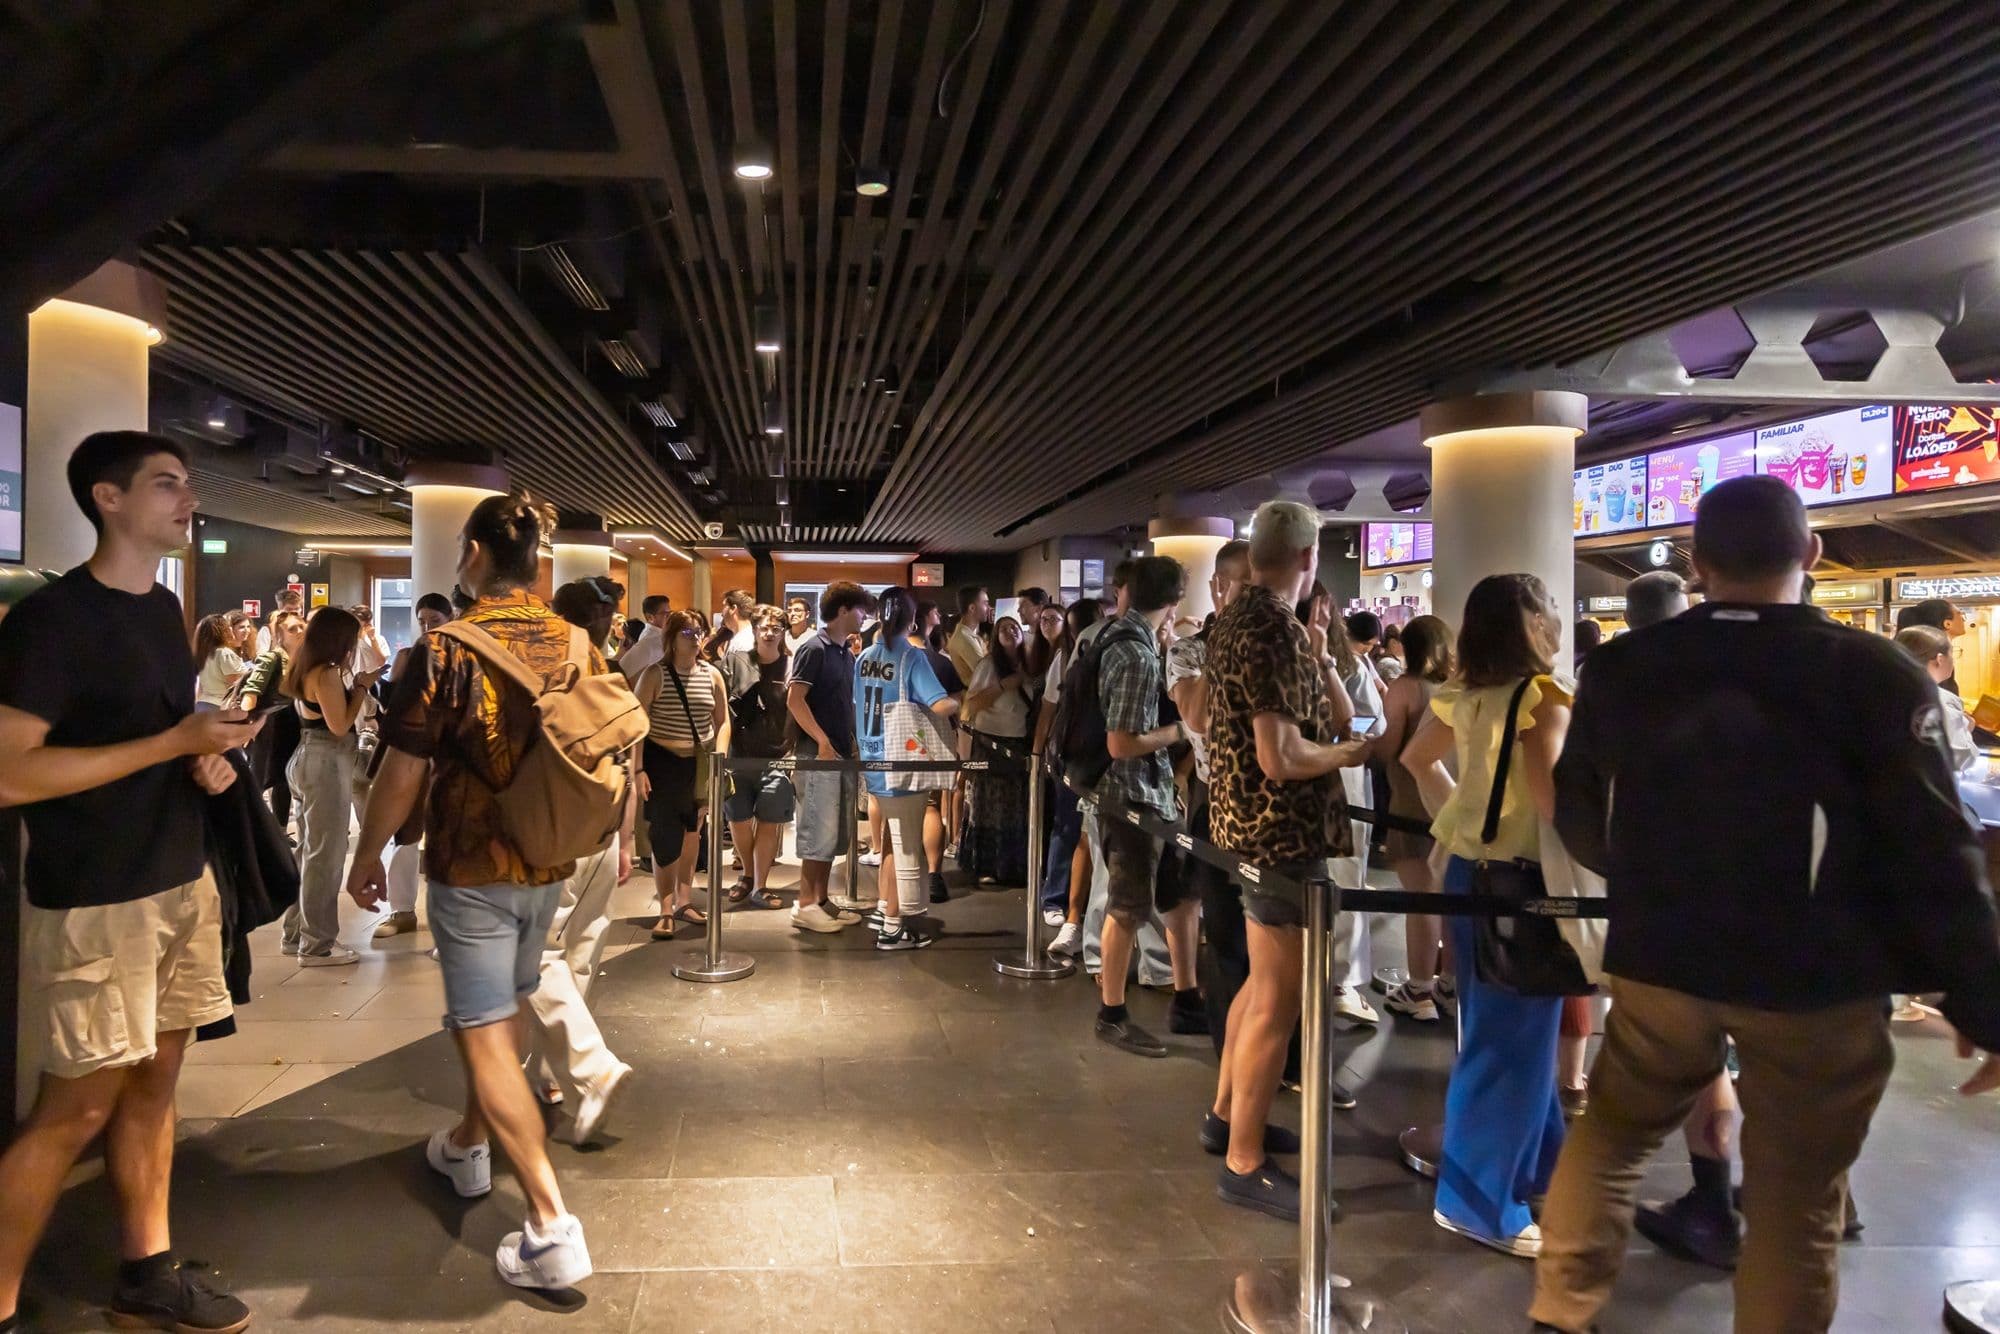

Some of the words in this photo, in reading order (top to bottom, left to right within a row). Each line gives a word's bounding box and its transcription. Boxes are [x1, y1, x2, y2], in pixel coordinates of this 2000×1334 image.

[1913, 409, 1950, 424] SABOR
[1760, 424, 1805, 440] FAMILIAR
[1906, 440, 1958, 458] LOADED
[1608, 463, 1624, 472] DUO
